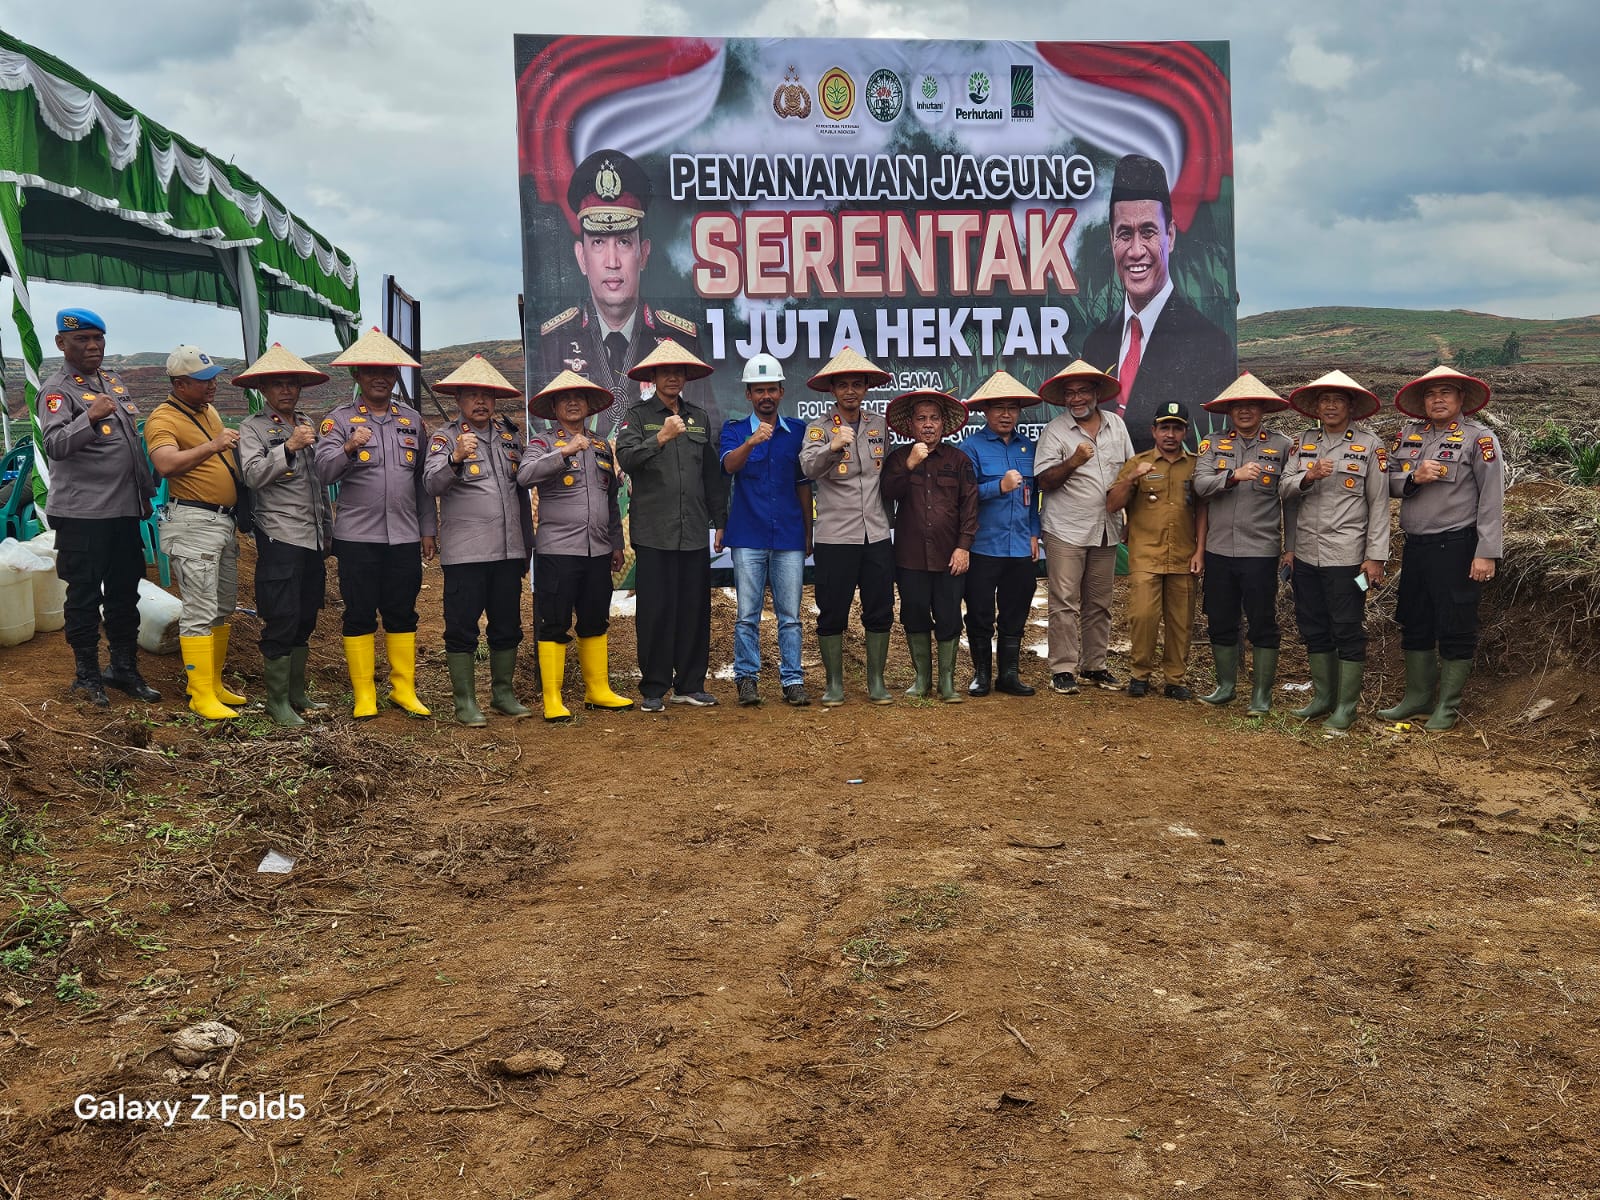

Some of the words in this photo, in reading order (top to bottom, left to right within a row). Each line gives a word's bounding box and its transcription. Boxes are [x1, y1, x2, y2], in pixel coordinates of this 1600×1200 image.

[916, 101, 944, 110] Inhutani
[955, 108, 1003, 120] Perhutani
[670, 154, 927, 201] PENANAMAN
[931, 154, 1096, 200] JAGUNG
[692, 208, 1080, 299] SERENTAK
[706, 308, 725, 359] 1
[735, 308, 866, 359] JUTA
[876, 306, 1070, 358] HEKTAR
[899, 371, 943, 391] SAMA
[1343, 453, 1368, 461] POLRI
